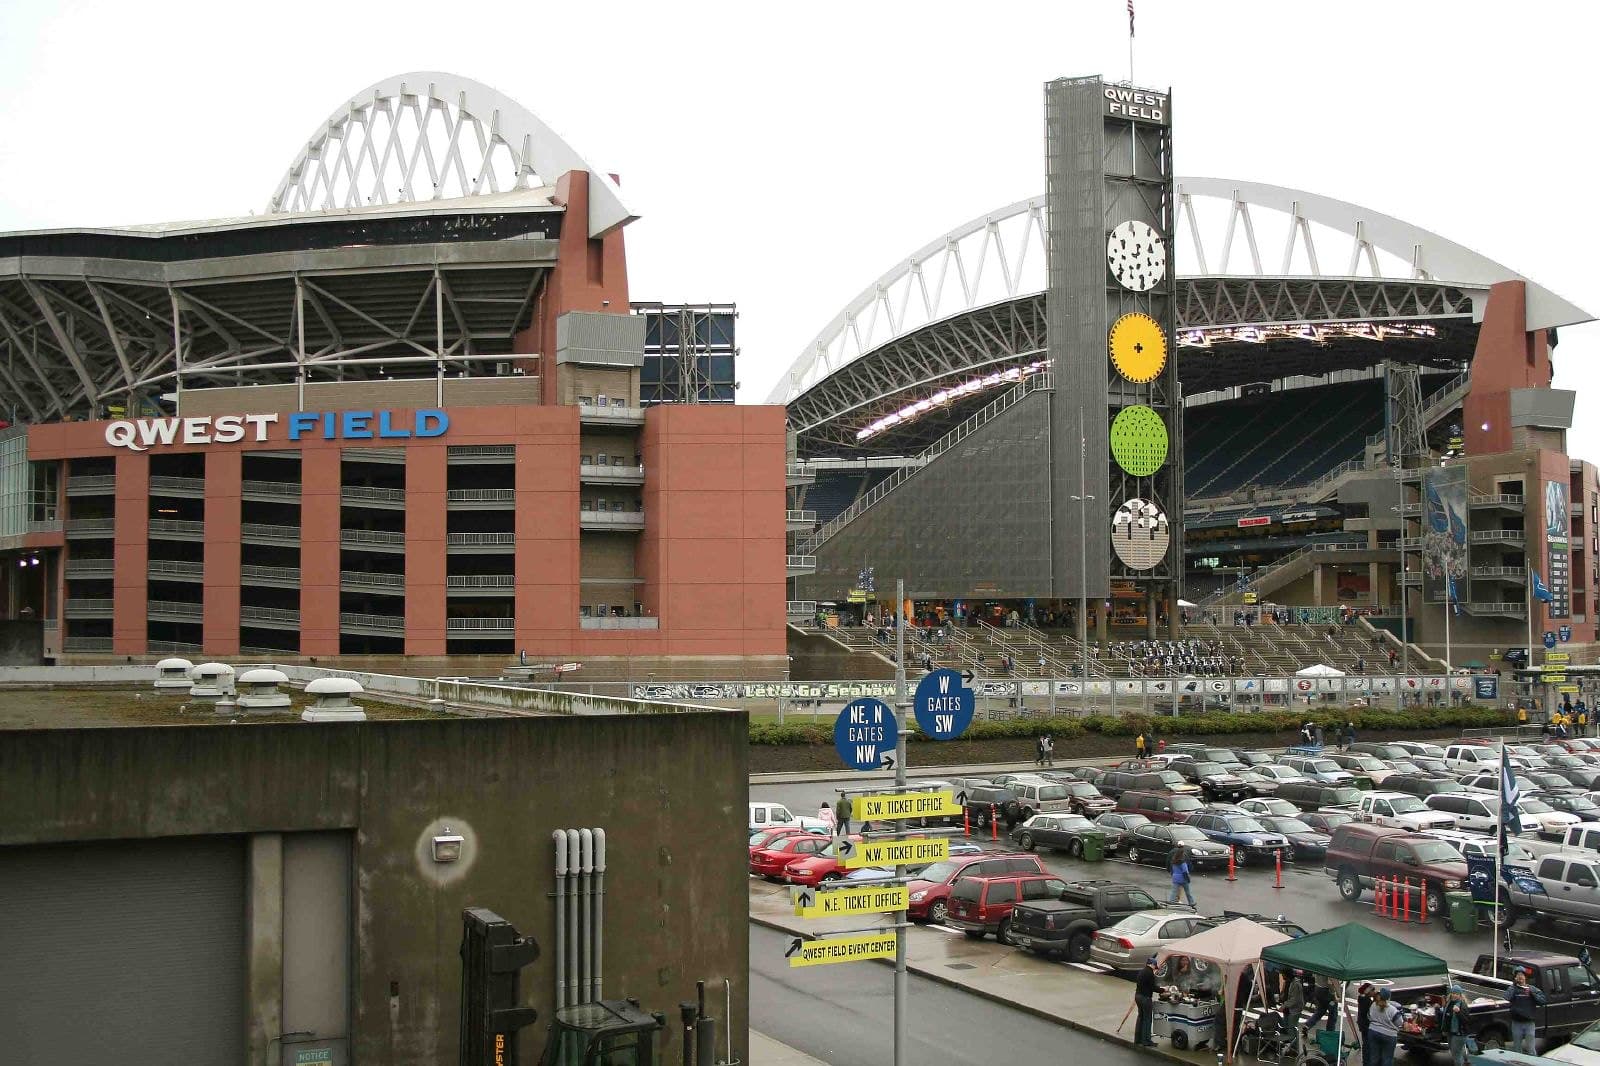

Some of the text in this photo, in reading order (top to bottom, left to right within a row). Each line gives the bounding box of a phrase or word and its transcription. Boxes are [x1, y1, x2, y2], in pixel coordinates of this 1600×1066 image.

[1104, 89, 1167, 108] QWEST
[1109, 102, 1163, 121] FIELD
[105, 409, 449, 451] QWEST FIELD
[745, 684, 917, 698] Let's Go Seahaws
[939, 675, 950, 694] W
[928, 696, 961, 712] GATES
[850, 705, 882, 724] NE, N
[935, 714, 954, 733] SW
[849, 726, 883, 742] GATES
[856, 744, 876, 764] NW
[867, 797, 942, 815] S.W. TICKET OFFICE
[865, 843, 943, 862] N.W. TICKET OFFICE
[824, 892, 902, 912] N.E. TICKET OFFICE
[803, 940, 896, 961] QWEST FIELD EVENT CENTER
[299, 1051, 329, 1062] NOTICE
